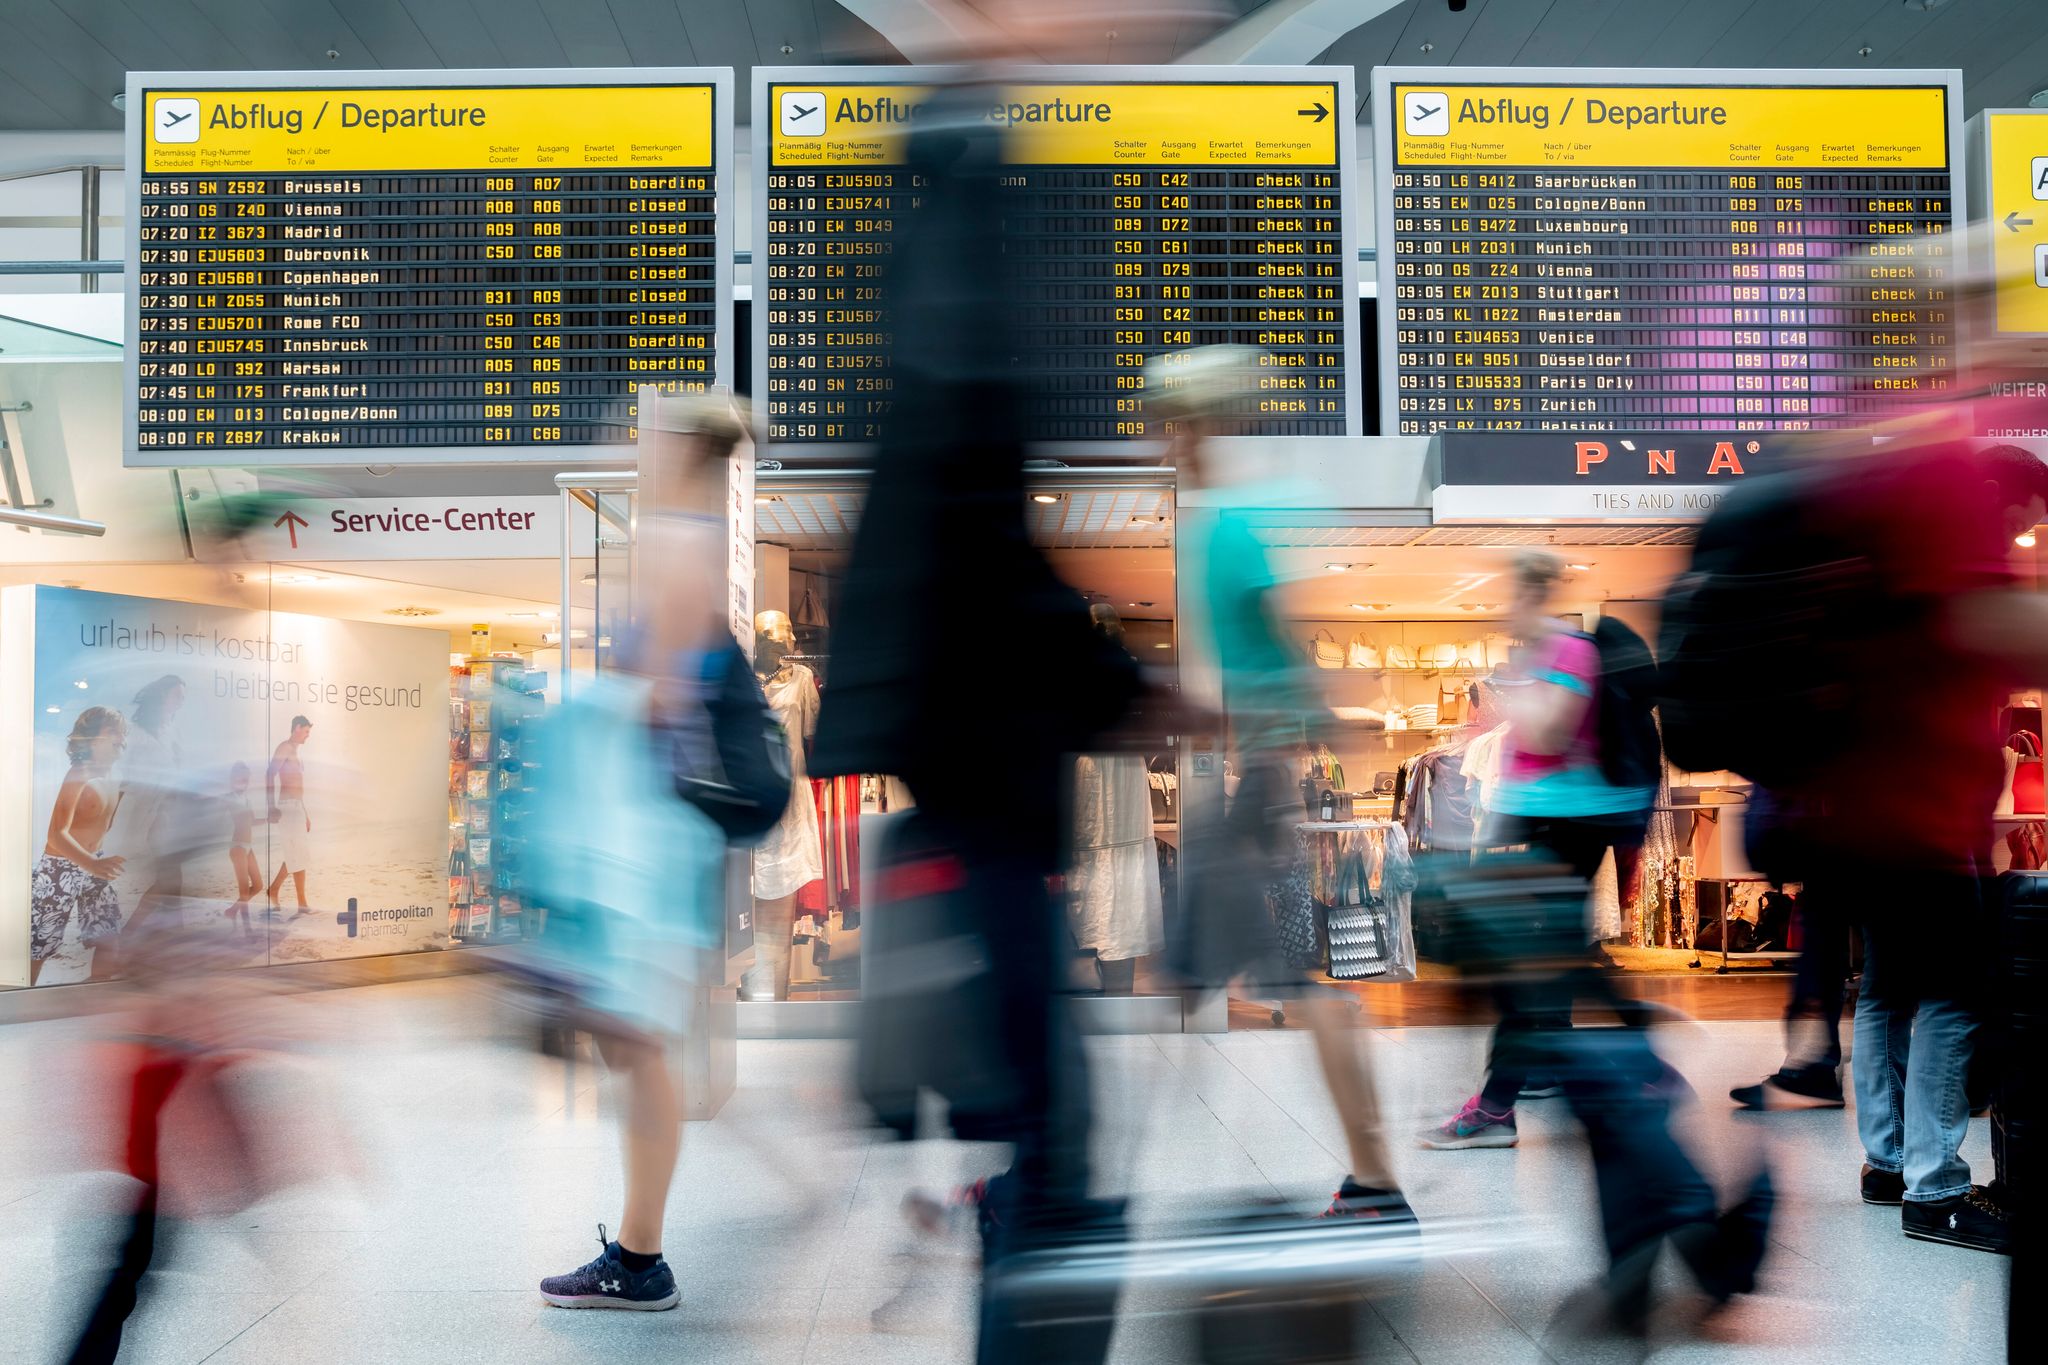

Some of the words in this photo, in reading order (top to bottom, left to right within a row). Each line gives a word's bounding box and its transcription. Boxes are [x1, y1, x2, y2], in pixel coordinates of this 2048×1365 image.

[209, 104, 302, 134] Abflug
[342, 103, 485, 133] Departure
[1458, 99, 1548, 129] Abflug
[1587, 100, 1726, 129] Departure
[286, 147, 306, 155] Nach
[313, 147, 331, 155] über
[488, 145, 520, 153] Schalter
[536, 144, 570, 154] Ausgang
[584, 144, 615, 152] Erwartet
[630, 143, 683, 153] Bemerkungen
[1113, 140, 1148, 148] Schalter
[1161, 140, 1197, 150] Ausgang
[1209, 140, 1243, 149] Erwartet
[1255, 141, 1312, 150] Bemerkungen
[1543, 142, 1564, 150] Nach
[1573, 143, 1592, 151] über
[1729, 143, 1762, 152] Schalter
[1775, 144, 1810, 153] Ausgang
[1821, 144, 1855, 152] Erwartet
[1866, 144, 1922, 153] Bemerkungen
[154, 159, 194, 167] Scheduled
[200, 159, 254, 168] Flight-Number
[286, 157, 296, 166] To
[304, 158, 317, 167] via
[488, 155, 519, 164] Counter
[536, 155, 554, 163] Gate
[583, 154, 618, 163] Expected
[630, 154, 663, 162] Remarks
[779, 152, 823, 160] Scheduled
[826, 151, 886, 162] Flight-Number
[1113, 150, 1146, 159] Counter
[1161, 150, 1181, 159] Gate
[1209, 150, 1247, 160] Expected
[1255, 150, 1292, 159] Remarks
[1404, 151, 1447, 160] Scheduled
[1450, 152, 1507, 161] Flight-Number
[1544, 152, 1554, 161] To
[1729, 153, 1761, 161] Counter
[1775, 153, 1794, 162] Gate
[1820, 153, 1860, 164] Expected
[1867, 154, 1903, 162] Remarks
[142, 182, 189, 195] 06:55
[200, 181, 217, 195] SN
[228, 181, 265, 194] 2592
[286, 180, 361, 194] Brussels
[487, 178, 514, 191] A06
[535, 177, 562, 191] A07
[630, 176, 706, 191] boarding
[142, 204, 189, 218] 07:00
[238, 203, 265, 217] 240
[285, 203, 342, 216] Vienna
[486, 201, 514, 214] A08
[534, 200, 561, 213] A06
[630, 199, 686, 212] closed
[769, 197, 816, 211] 08:10
[827, 197, 890, 210] EJU5741
[1115, 196, 1141, 209] C50
[1162, 196, 1189, 209] C40
[1257, 196, 1303, 209] check
[1316, 196, 1332, 209] in
[1396, 219, 1442, 232] 08:55
[1481, 219, 1517, 232] 9472
[1537, 219, 1628, 235] Luxembourg
[1732, 220, 1758, 233] A06
[1778, 221, 1802, 234] A11
[1870, 221, 1914, 234] check
[1927, 221, 1942, 234] in
[141, 271, 187, 286] 07:30
[284, 271, 379, 286] Copenhagen
[630, 266, 687, 280] closed
[141, 295, 188, 308] 07:30
[198, 295, 216, 308] LH
[227, 294, 264, 308] 2055
[284, 293, 341, 307] Munich
[486, 291, 511, 304] B31
[534, 290, 561, 303] A09
[630, 289, 687, 302] closed
[141, 340, 187, 354] 07:40
[198, 339, 264, 353] EJU5745
[284, 338, 369, 352] Innsbruck
[485, 336, 513, 349] C50
[534, 335, 561, 349] C46
[630, 334, 705, 349] boarding
[769, 333, 816, 347] 08:35
[1116, 331, 1143, 344] C50
[1164, 331, 1191, 344] C40
[1260, 331, 1305, 344] check
[1319, 331, 1334, 344] in
[1399, 330, 1445, 343] 09:10
[1455, 331, 1520, 344] EJU4653
[1540, 331, 1594, 344] Venice
[1734, 332, 1761, 345] C50
[1780, 332, 1807, 345] C48
[1873, 333, 1917, 345] check
[1930, 333, 1946, 345] in
[1400, 353, 1445, 366] 09:10
[1456, 353, 1473, 366] EW
[1484, 353, 1518, 366] 9051
[1540, 353, 1631, 367] Düsseldorf
[1874, 355, 1918, 367] check
[1931, 355, 1947, 367] in
[140, 409, 187, 422] 08:00
[197, 408, 215, 422] EW
[235, 408, 264, 421] 013
[284, 406, 397, 422] Cologne/Bonn
[769, 400, 816, 415] 08:45
[828, 401, 845, 414] LH
[1118, 399, 1142, 412] B31
[1261, 399, 1307, 412] check
[1320, 399, 1336, 412] in
[1592, 493, 1631, 509] TIES
[1637, 493, 1674, 509] AND
[331, 508, 535, 532] Service-Center
[80, 618, 166, 653] urlaub
[173, 625, 206, 657] ist
[213, 630, 303, 664] kostbar
[213, 670, 301, 701] bleiben
[307, 677, 339, 705] sie
[345, 683, 422, 712] gesund
[361, 904, 434, 925] metropolitan
[360, 921, 410, 940] pharmacy
